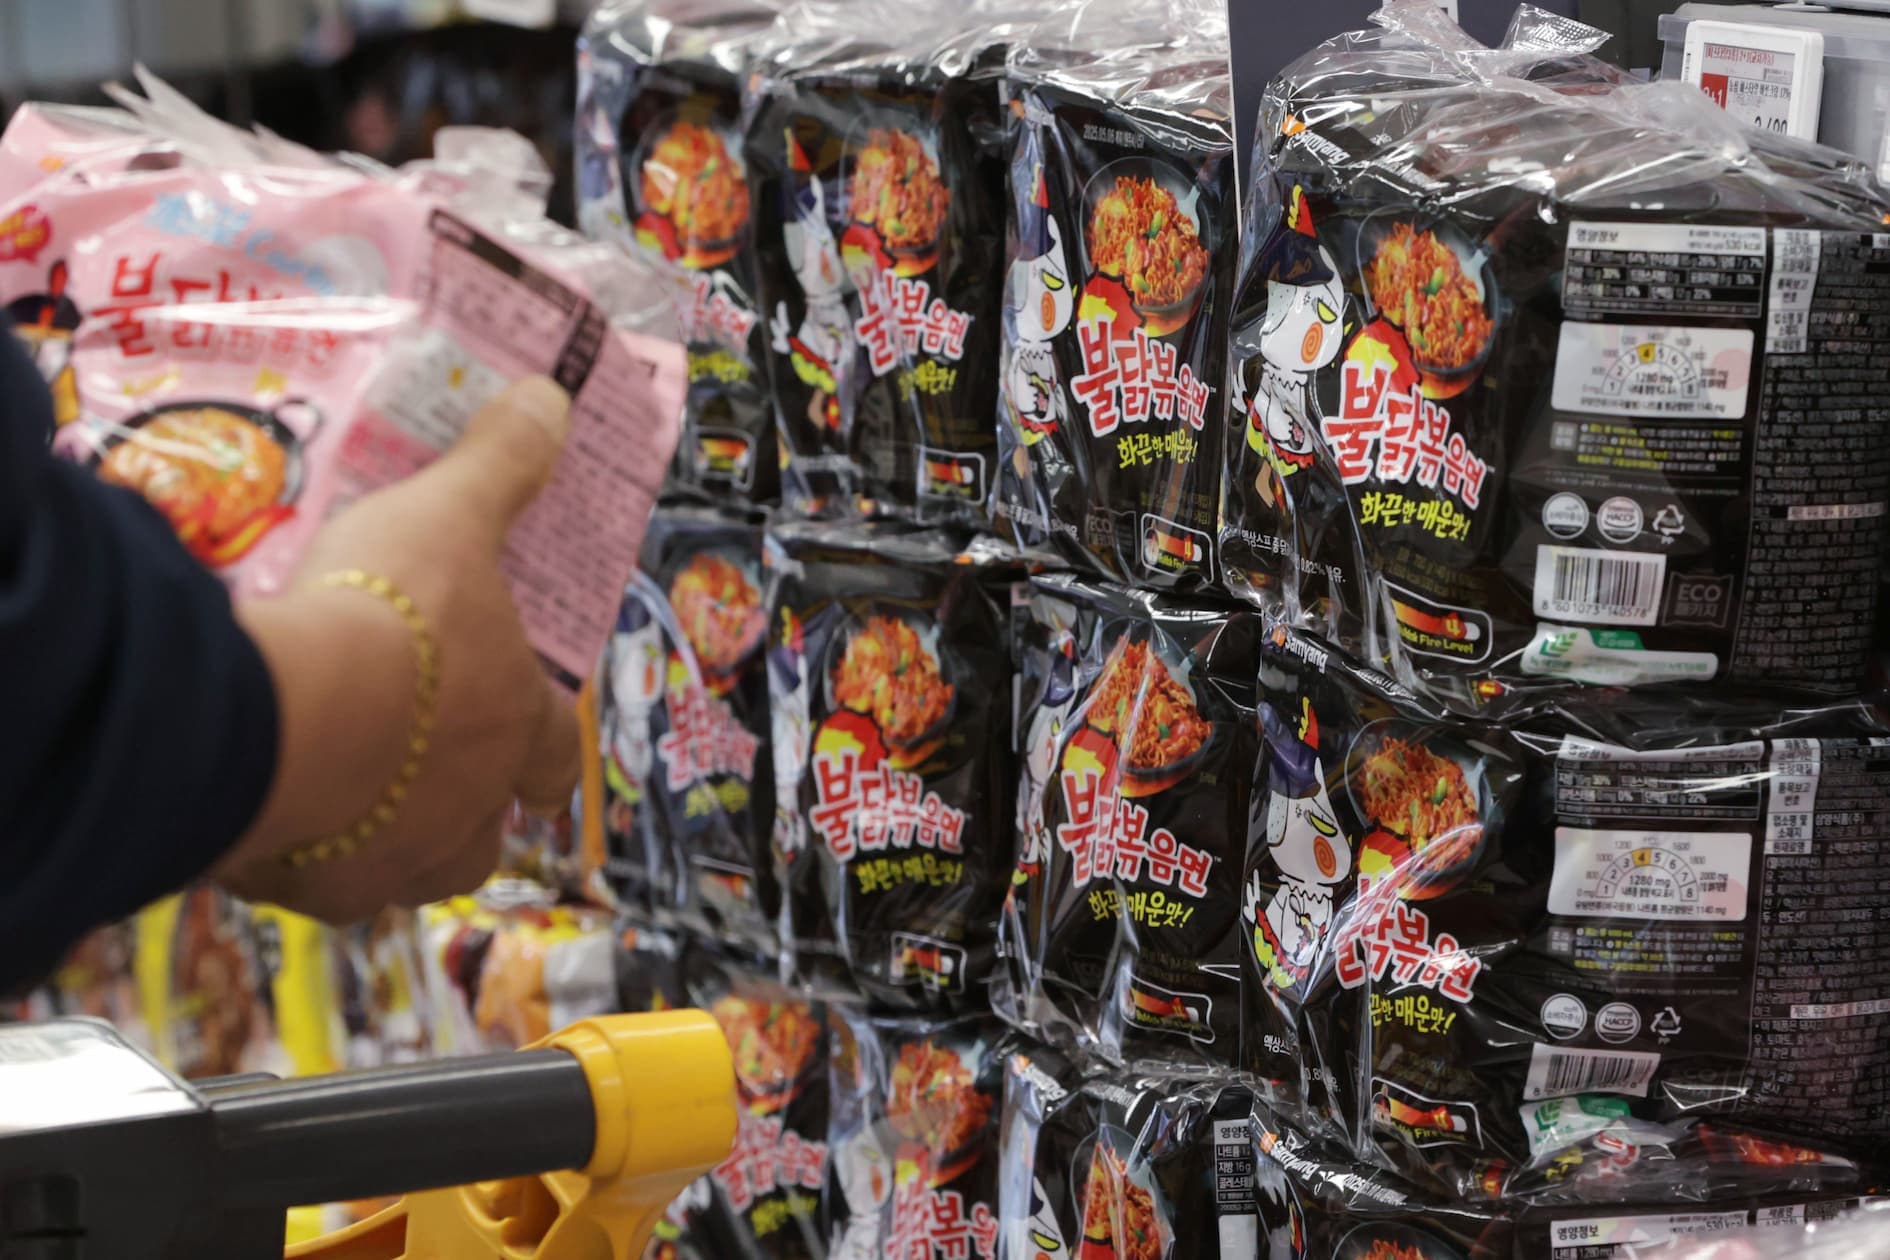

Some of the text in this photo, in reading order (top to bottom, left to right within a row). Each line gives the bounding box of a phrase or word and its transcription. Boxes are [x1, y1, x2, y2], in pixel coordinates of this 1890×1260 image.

[1070, 314, 1209, 438] 불닭볶음면
[1320, 360, 1487, 510] 불닭볶음면
[1116, 432, 1163, 469] 화끈한
[1360, 491, 1471, 541] 화끈한 매운맛!
[1678, 583, 1722, 602] ECO
[1445, 618, 1461, 637] 4
[1284, 631, 1329, 675] Samyang
[1419, 632, 1442, 649] Fire
[1443, 638, 1473, 655] Level
[809, 746, 963, 863] 불닭볶음면
[1057, 767, 1214, 898] 불닭볶음면
[1630, 874, 1671, 888] 1280 mg
[1126, 891, 1195, 928] 매운맛!
[1369, 993, 1456, 1035] 끈한 매운맛!
[1605, 1017, 1633, 1027] HACCP
[1221, 1126, 1251, 1139] 영양정
[1217, 1145, 1240, 1158] 나트륨
[1218, 1161, 1234, 1174] 지방
[1235, 1161, 1245, 1172] 16
[1218, 1177, 1255, 1190] 콜레스테
[1769, 1208, 1794, 1219] 제품명
[1557, 1224, 1600, 1241] 영양정보
[1706, 1219, 1725, 1232] 530
